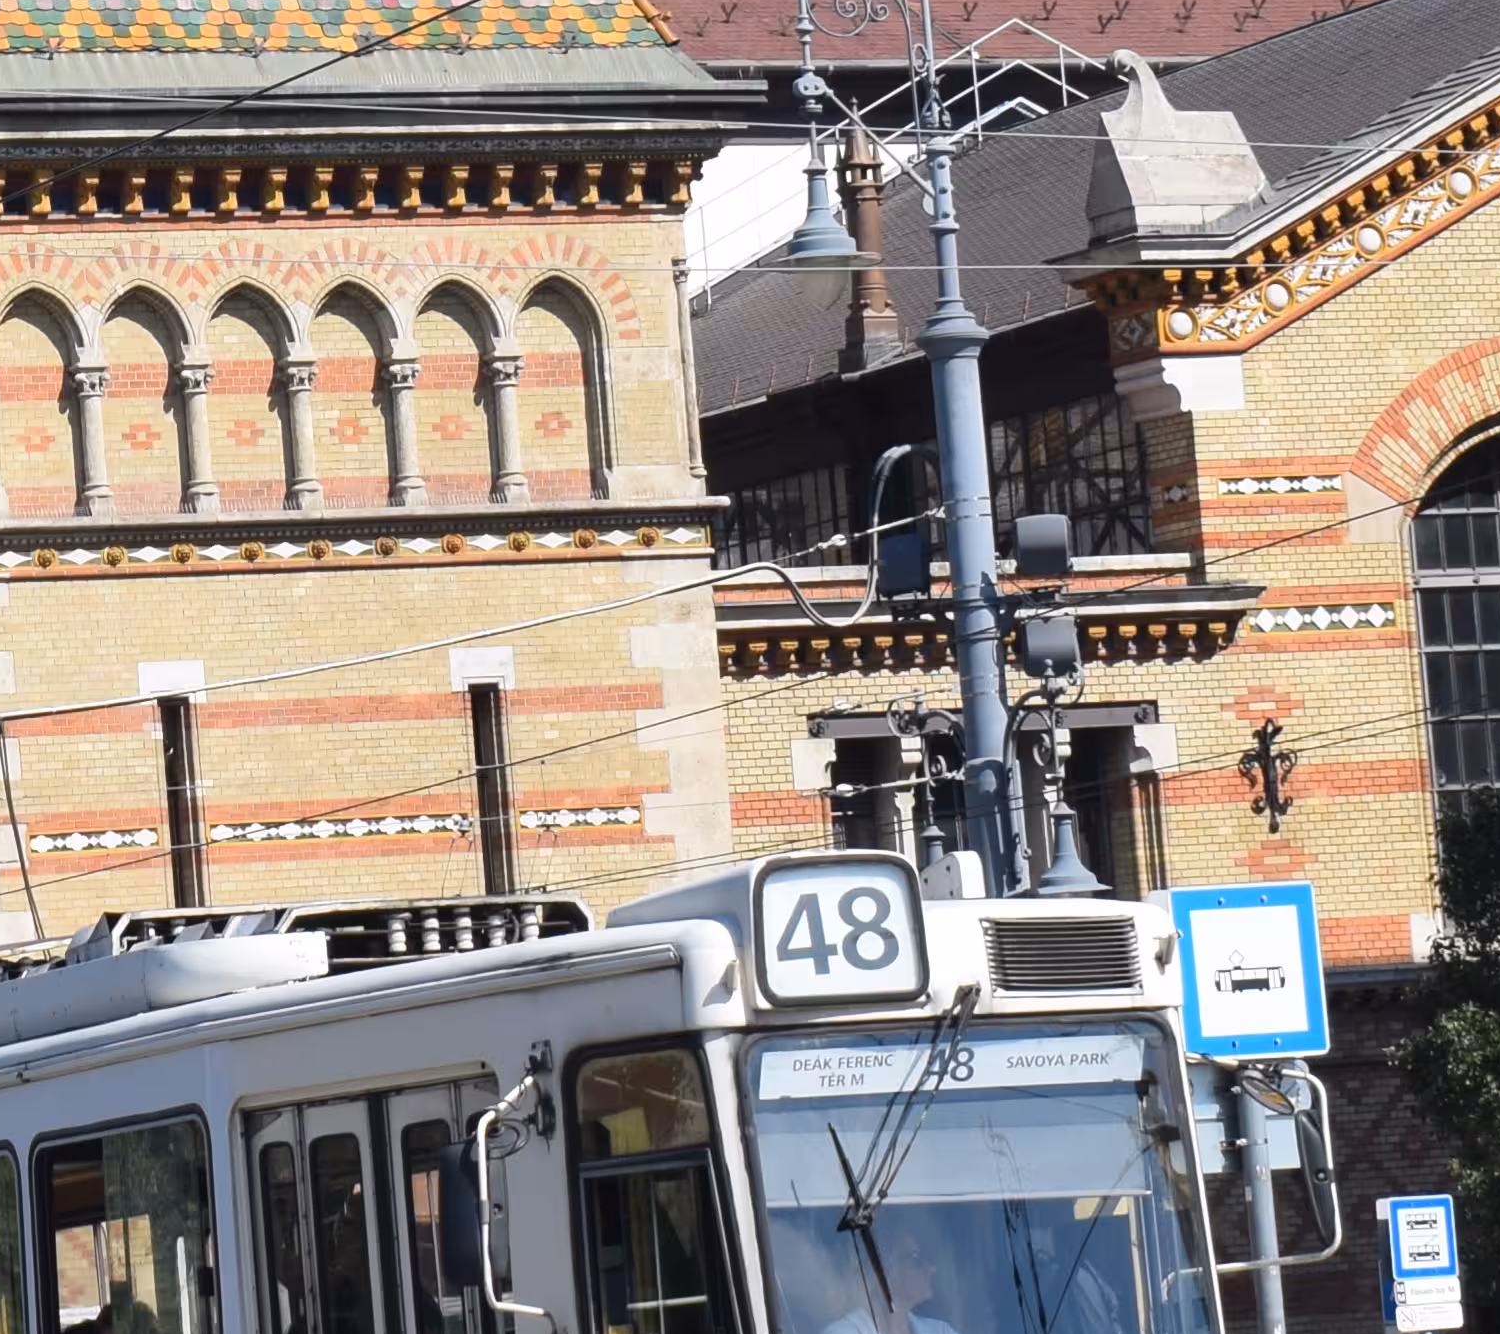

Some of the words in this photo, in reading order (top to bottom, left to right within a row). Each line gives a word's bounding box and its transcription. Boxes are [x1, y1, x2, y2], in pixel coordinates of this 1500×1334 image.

[776, 887, 900, 976] 48
[792, 1053, 833, 1072] DEÁK
[838, 1053, 894, 1069] FERENC
[927, 1047, 975, 1082] 48
[1006, 1052, 1065, 1069] SAVOYA
[1069, 1051, 1111, 1067] PARK
[818, 1070, 848, 1088] TÉR
[850, 1073, 865, 1087] M
